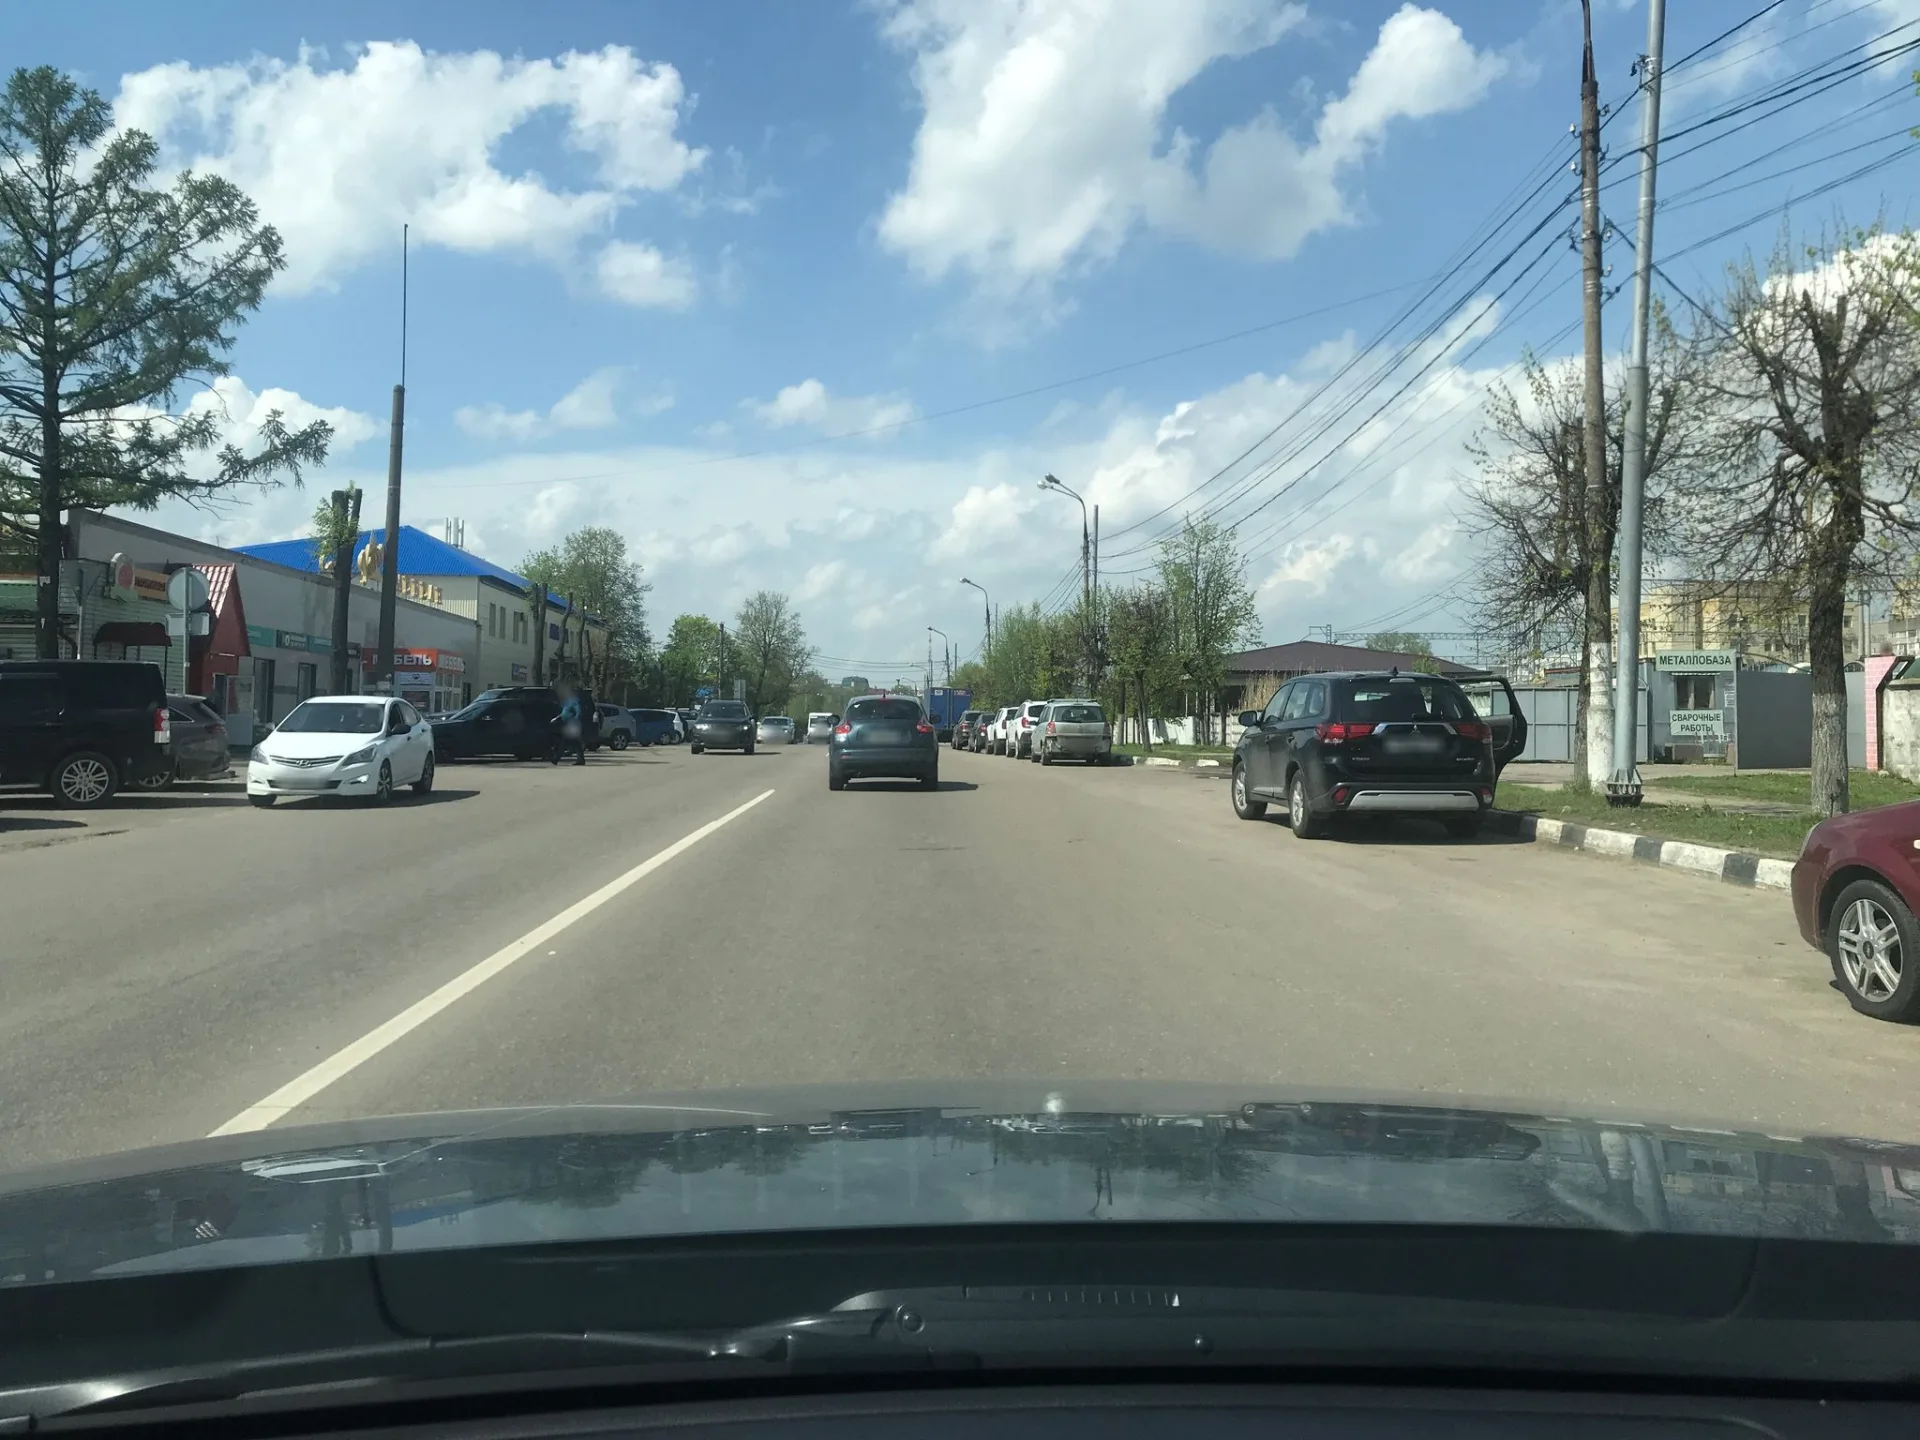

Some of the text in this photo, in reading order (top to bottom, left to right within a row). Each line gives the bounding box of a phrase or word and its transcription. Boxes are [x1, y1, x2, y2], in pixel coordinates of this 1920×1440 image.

[372, 654, 432, 666] БЕЛЬ
[1659, 655, 1732, 665] МЕТАЛЛОБАЗА
[1672, 713, 1721, 722] СВАРОЧНЫЕ
[1680, 723, 1714, 732] РАБОТЫ
